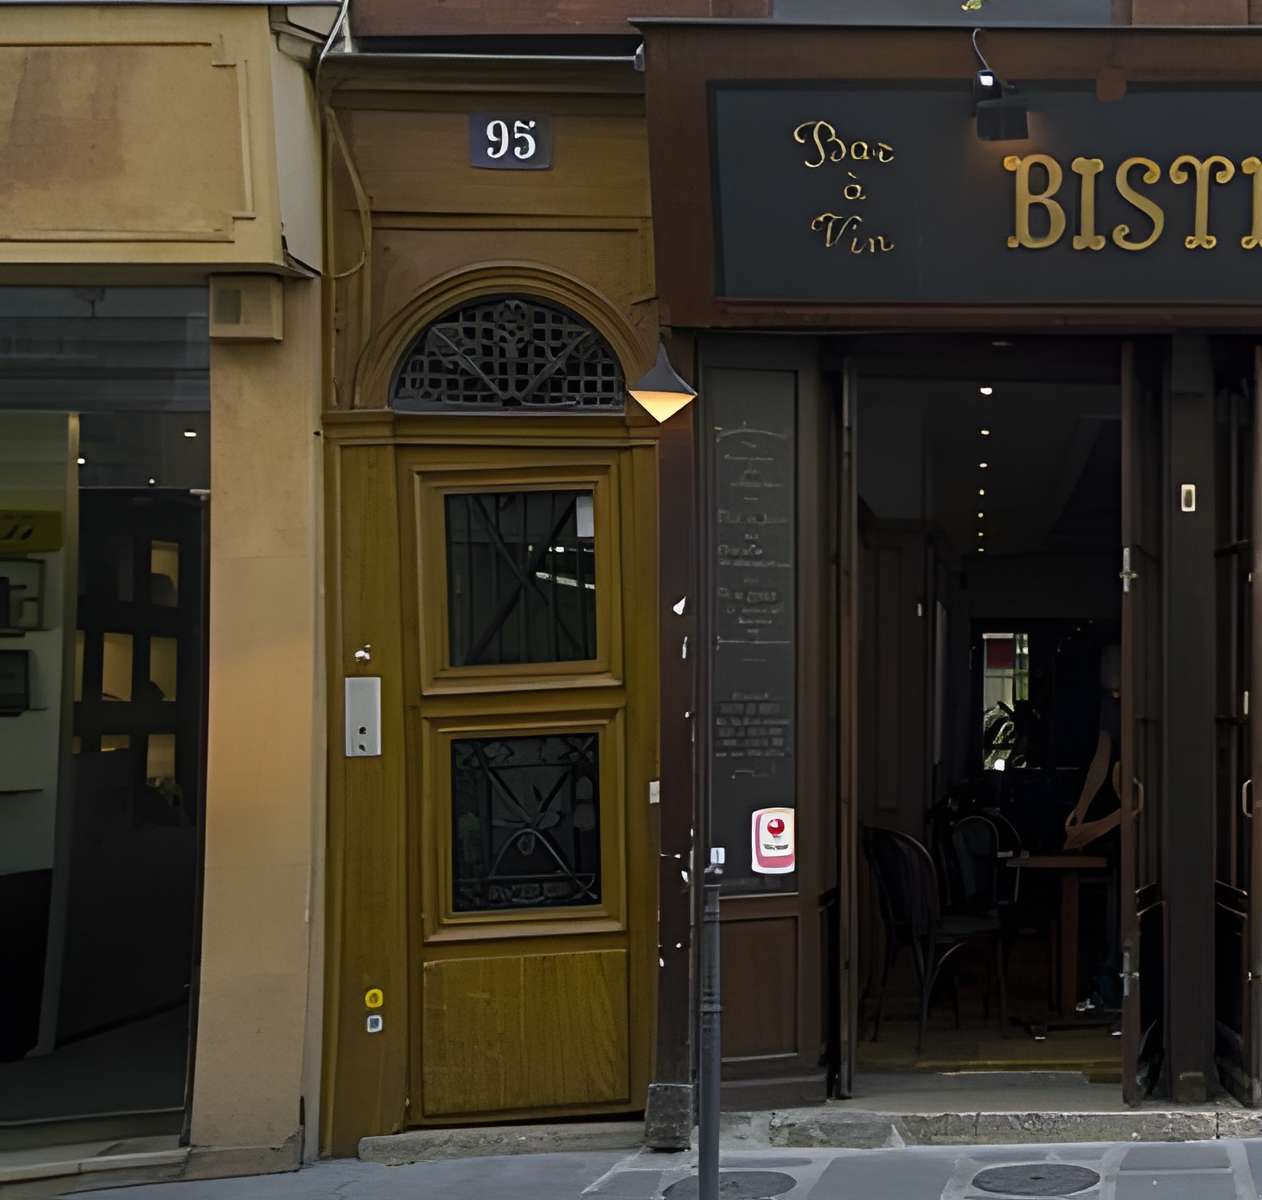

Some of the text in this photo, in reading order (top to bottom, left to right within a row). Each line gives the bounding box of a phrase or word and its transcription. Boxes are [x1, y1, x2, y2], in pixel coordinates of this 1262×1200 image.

[485, 119, 537, 161] 95
[793, 120, 895, 168] Bar
[843, 171, 867, 200] à
[810, 212, 895, 254] Vin
